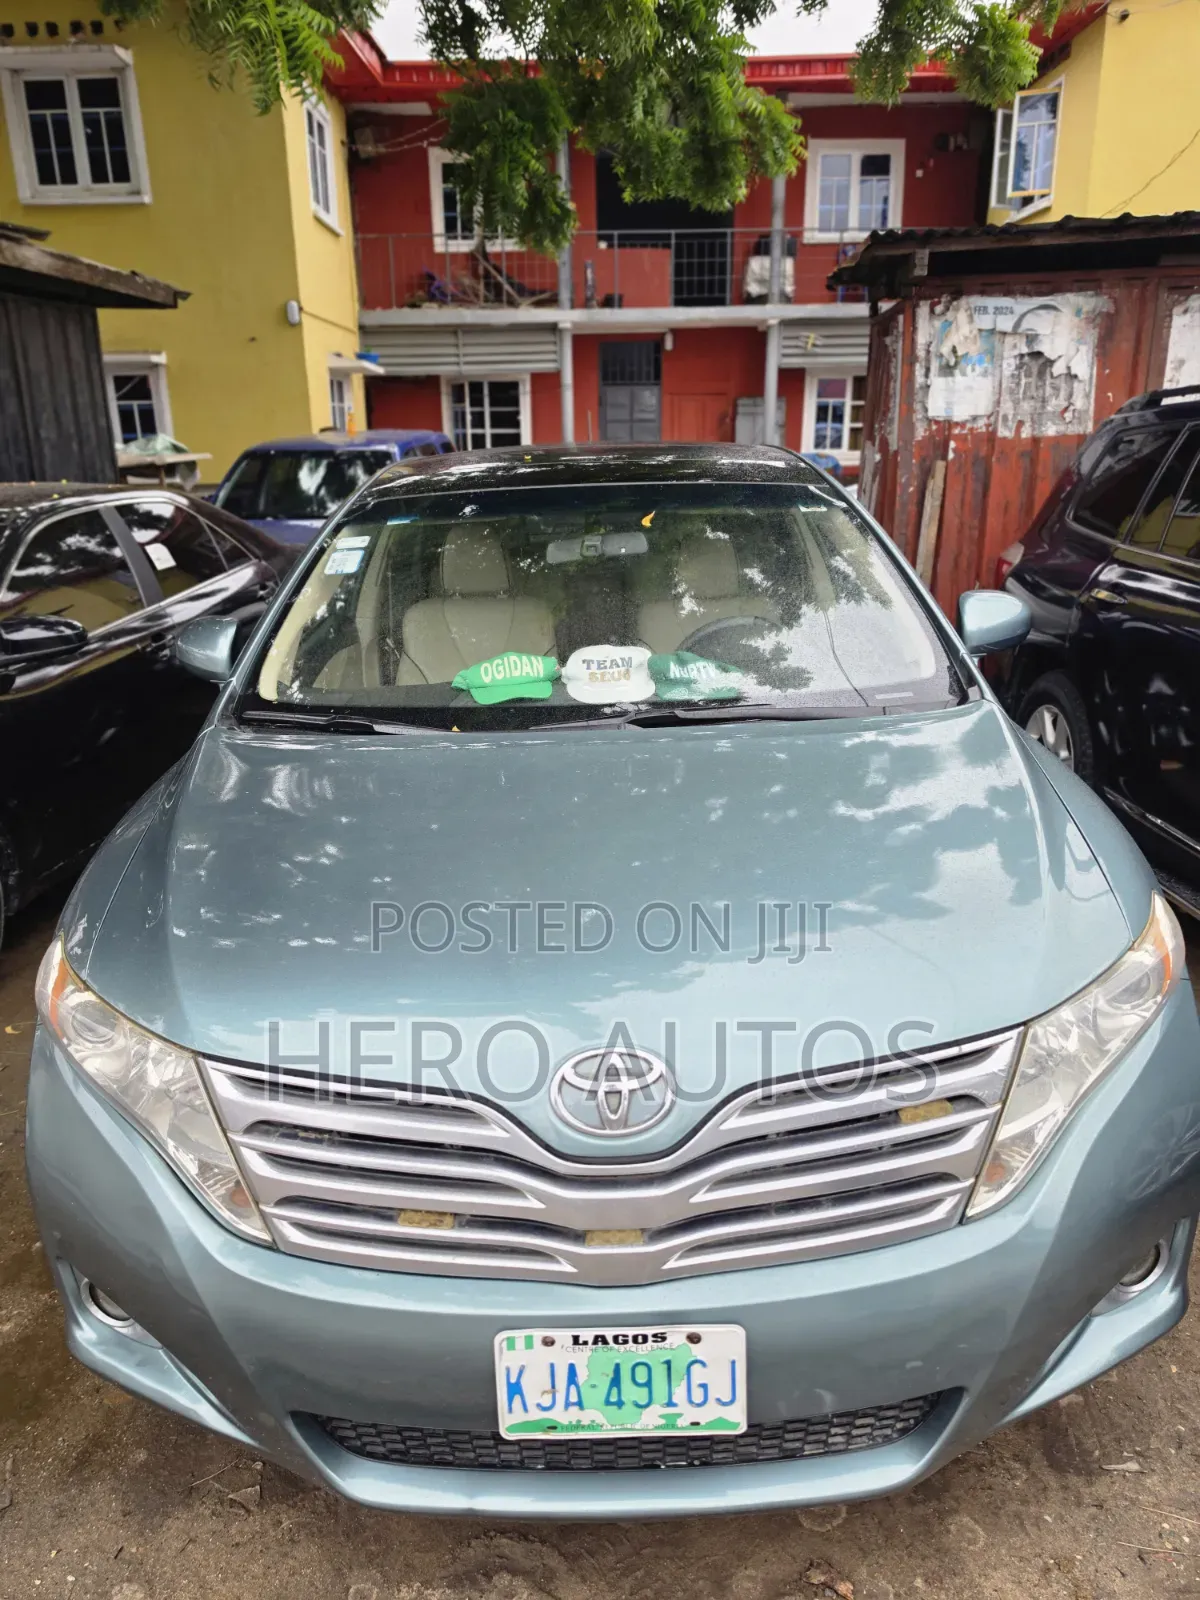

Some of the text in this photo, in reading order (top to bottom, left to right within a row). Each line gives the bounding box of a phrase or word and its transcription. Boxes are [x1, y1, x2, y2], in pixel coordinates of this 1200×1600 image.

[974, 305, 1014, 316] FEB. 2024
[480, 655, 544, 684] OGIDAN
[582, 657, 633, 670] TEAM
[571, 1332, 668, 1346] LAGOS
[602, 1345, 615, 1353] OF
[618, 1343, 675, 1353] EXCELLENCE
